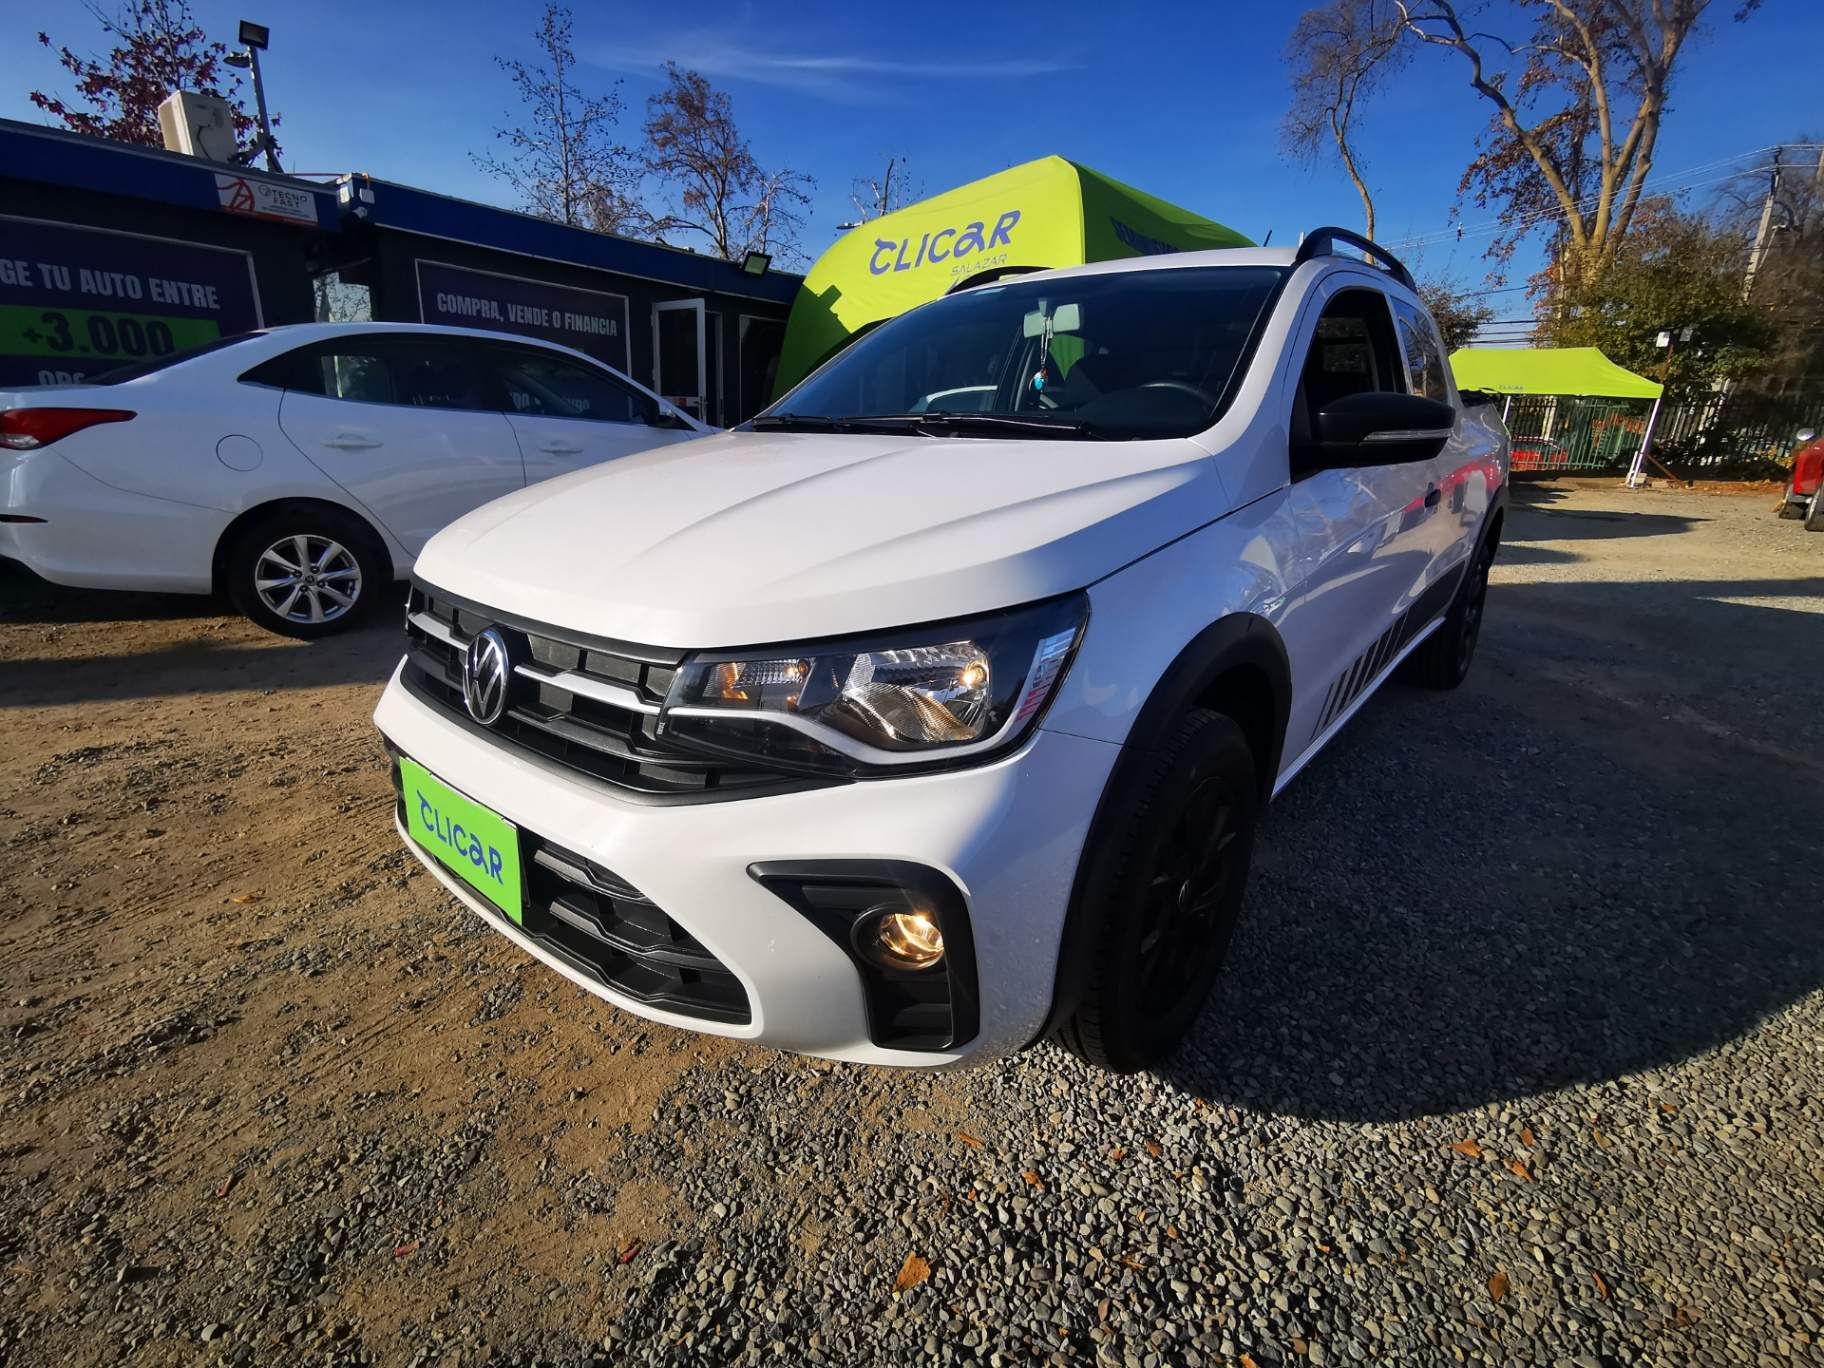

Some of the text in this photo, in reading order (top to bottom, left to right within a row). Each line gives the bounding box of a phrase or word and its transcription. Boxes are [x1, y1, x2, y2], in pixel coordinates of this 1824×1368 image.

[951, 254, 1008, 274] SALAZAR
[37, 263, 72, 292] TU
[79, 268, 144, 300] AUTO
[148, 277, 221, 310] ENTRE
[23, 312, 175, 356] +3.000
[436, 292, 618, 337] COMPRA, VENDE O FINANCIA
